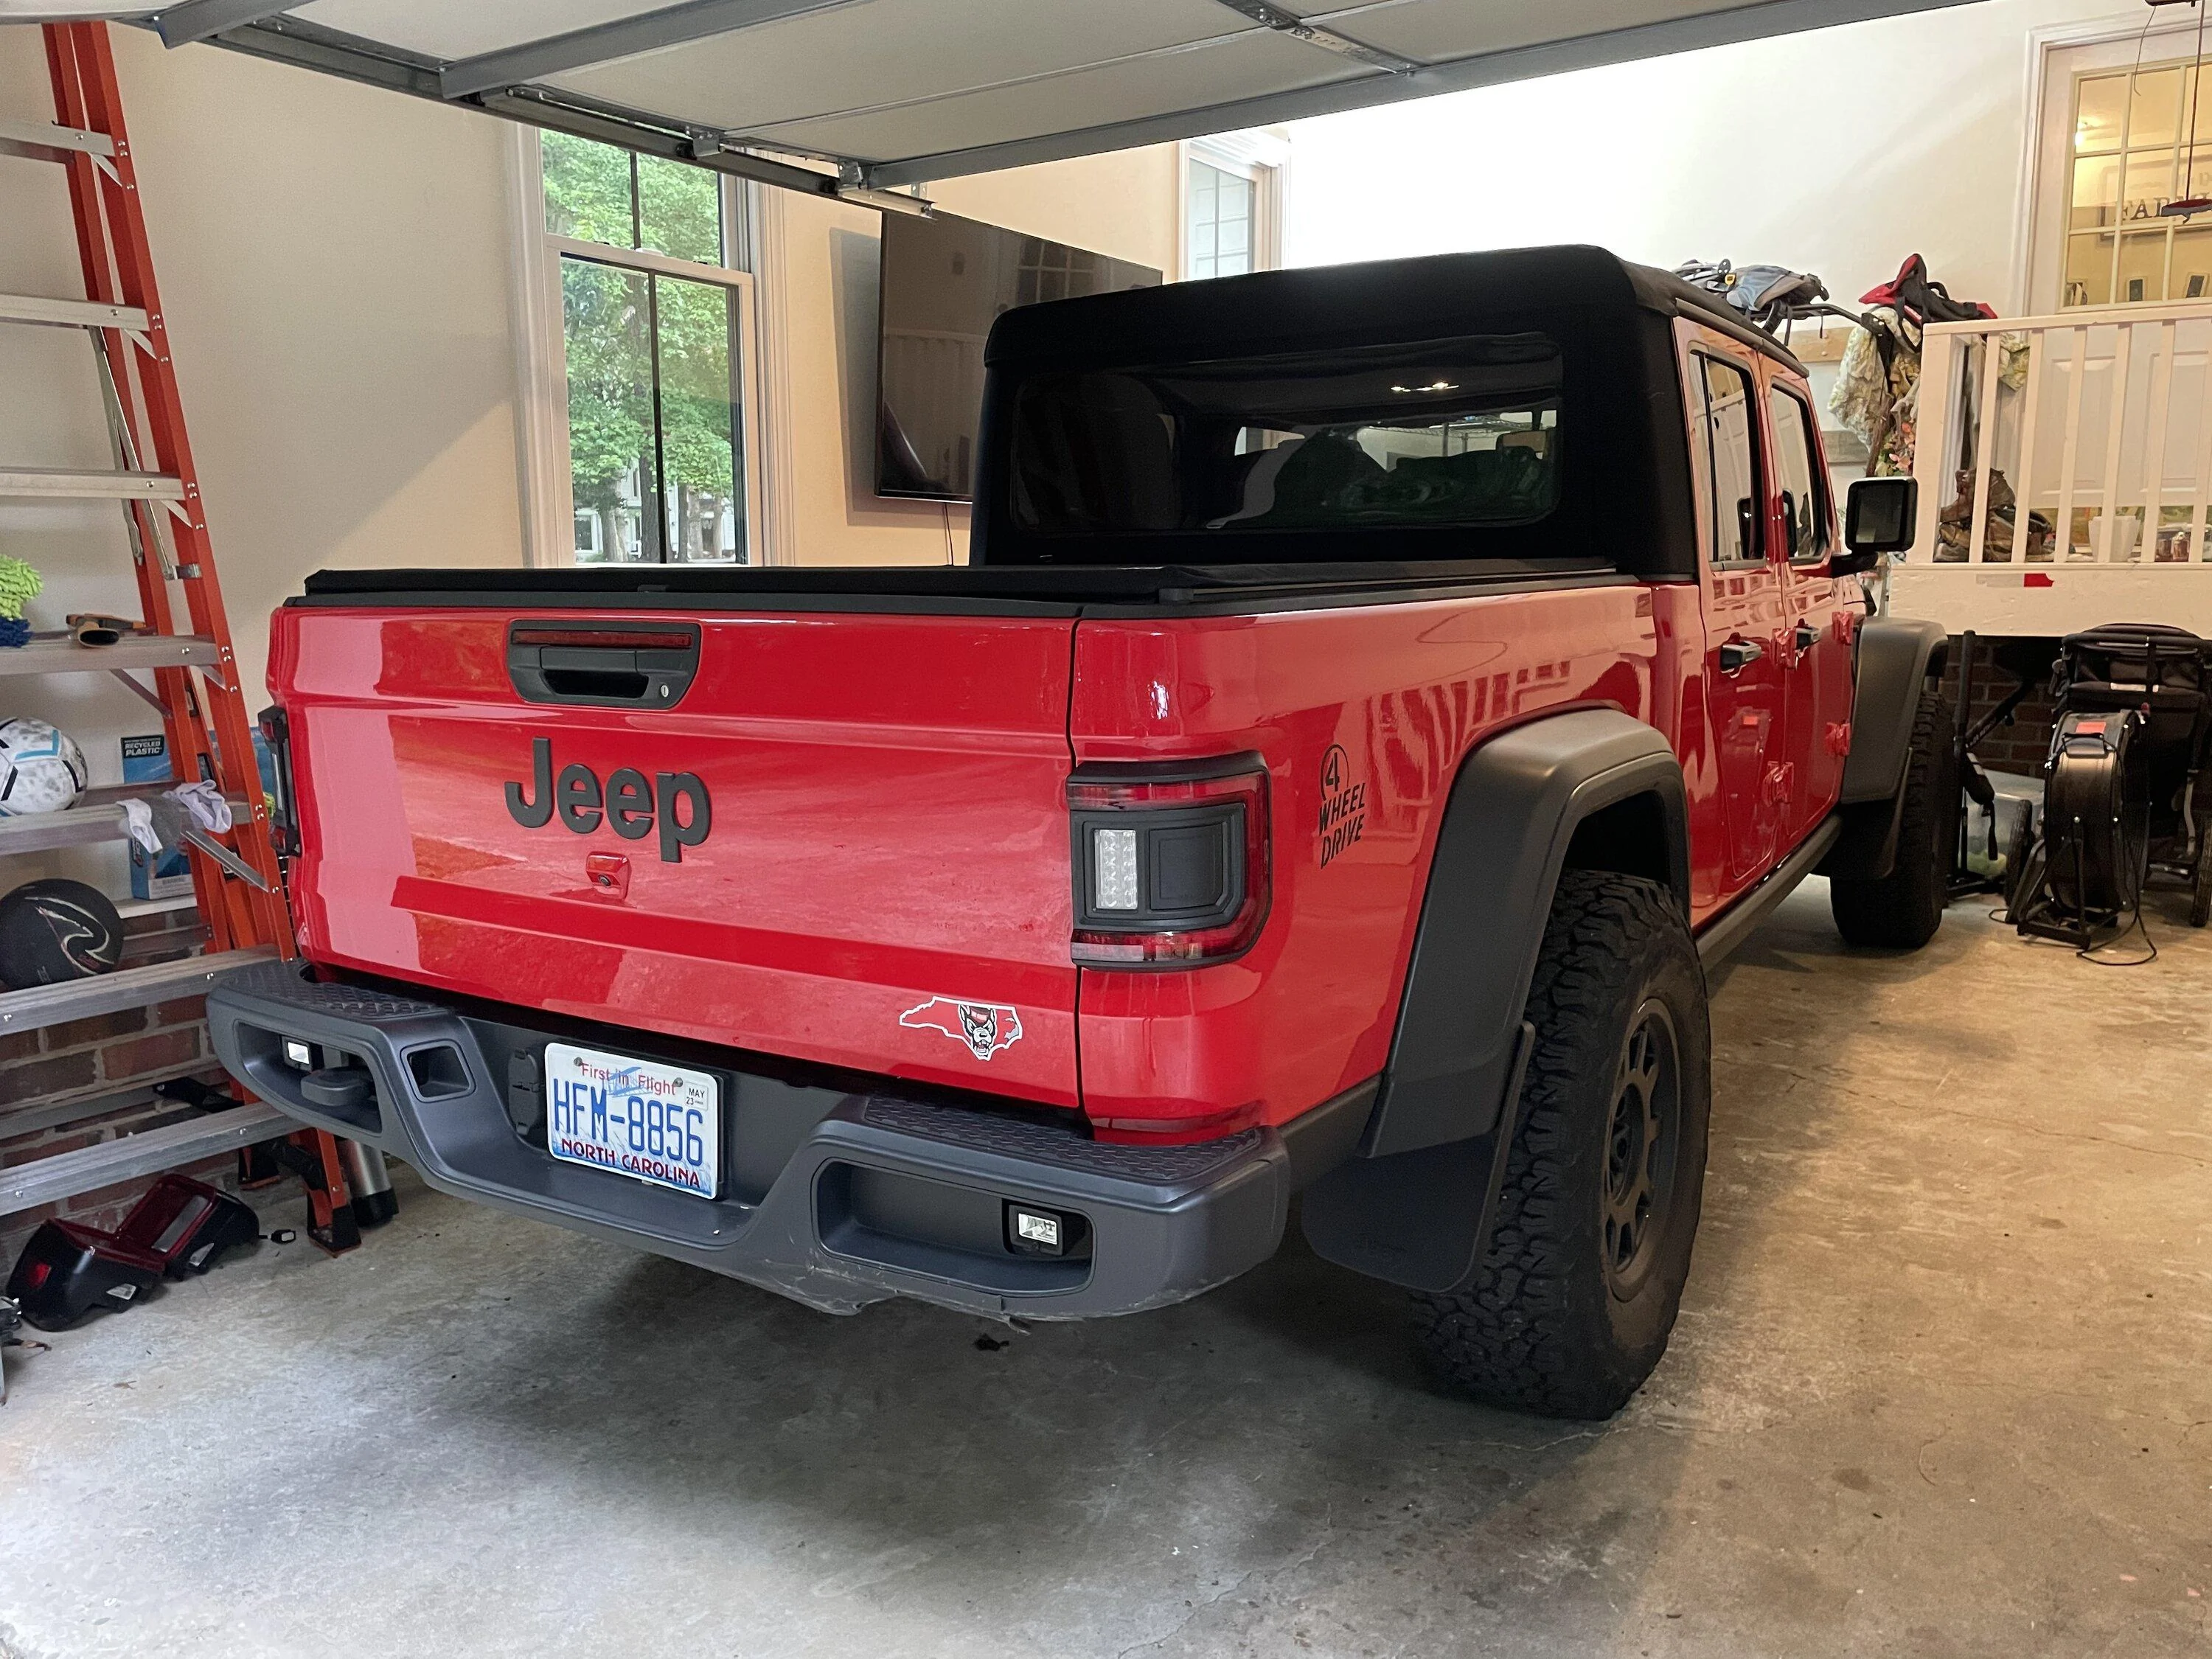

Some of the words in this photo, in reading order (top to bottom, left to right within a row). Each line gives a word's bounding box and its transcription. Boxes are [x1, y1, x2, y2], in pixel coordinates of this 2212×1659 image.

[125, 741, 161, 750] RECYCLED
[125, 747, 161, 757] PLASTIC
[1325, 752, 1340, 792] 4
[504, 736, 712, 863] Jeep
[1318, 782, 1366, 835] WHEEL
[1321, 814, 1366, 869] DRIVE
[581, 1062, 611, 1082] First
[616, 1068, 630, 1084] in
[638, 1074, 677, 1096] Flight
[689, 1088, 705, 1099] MAY
[686, 1097, 694, 1105] 23
[553, 1078, 703, 1166] HFM-8856
[561, 1138, 616, 1166] NORTH
[622, 1154, 700, 1188] CAROLINA
